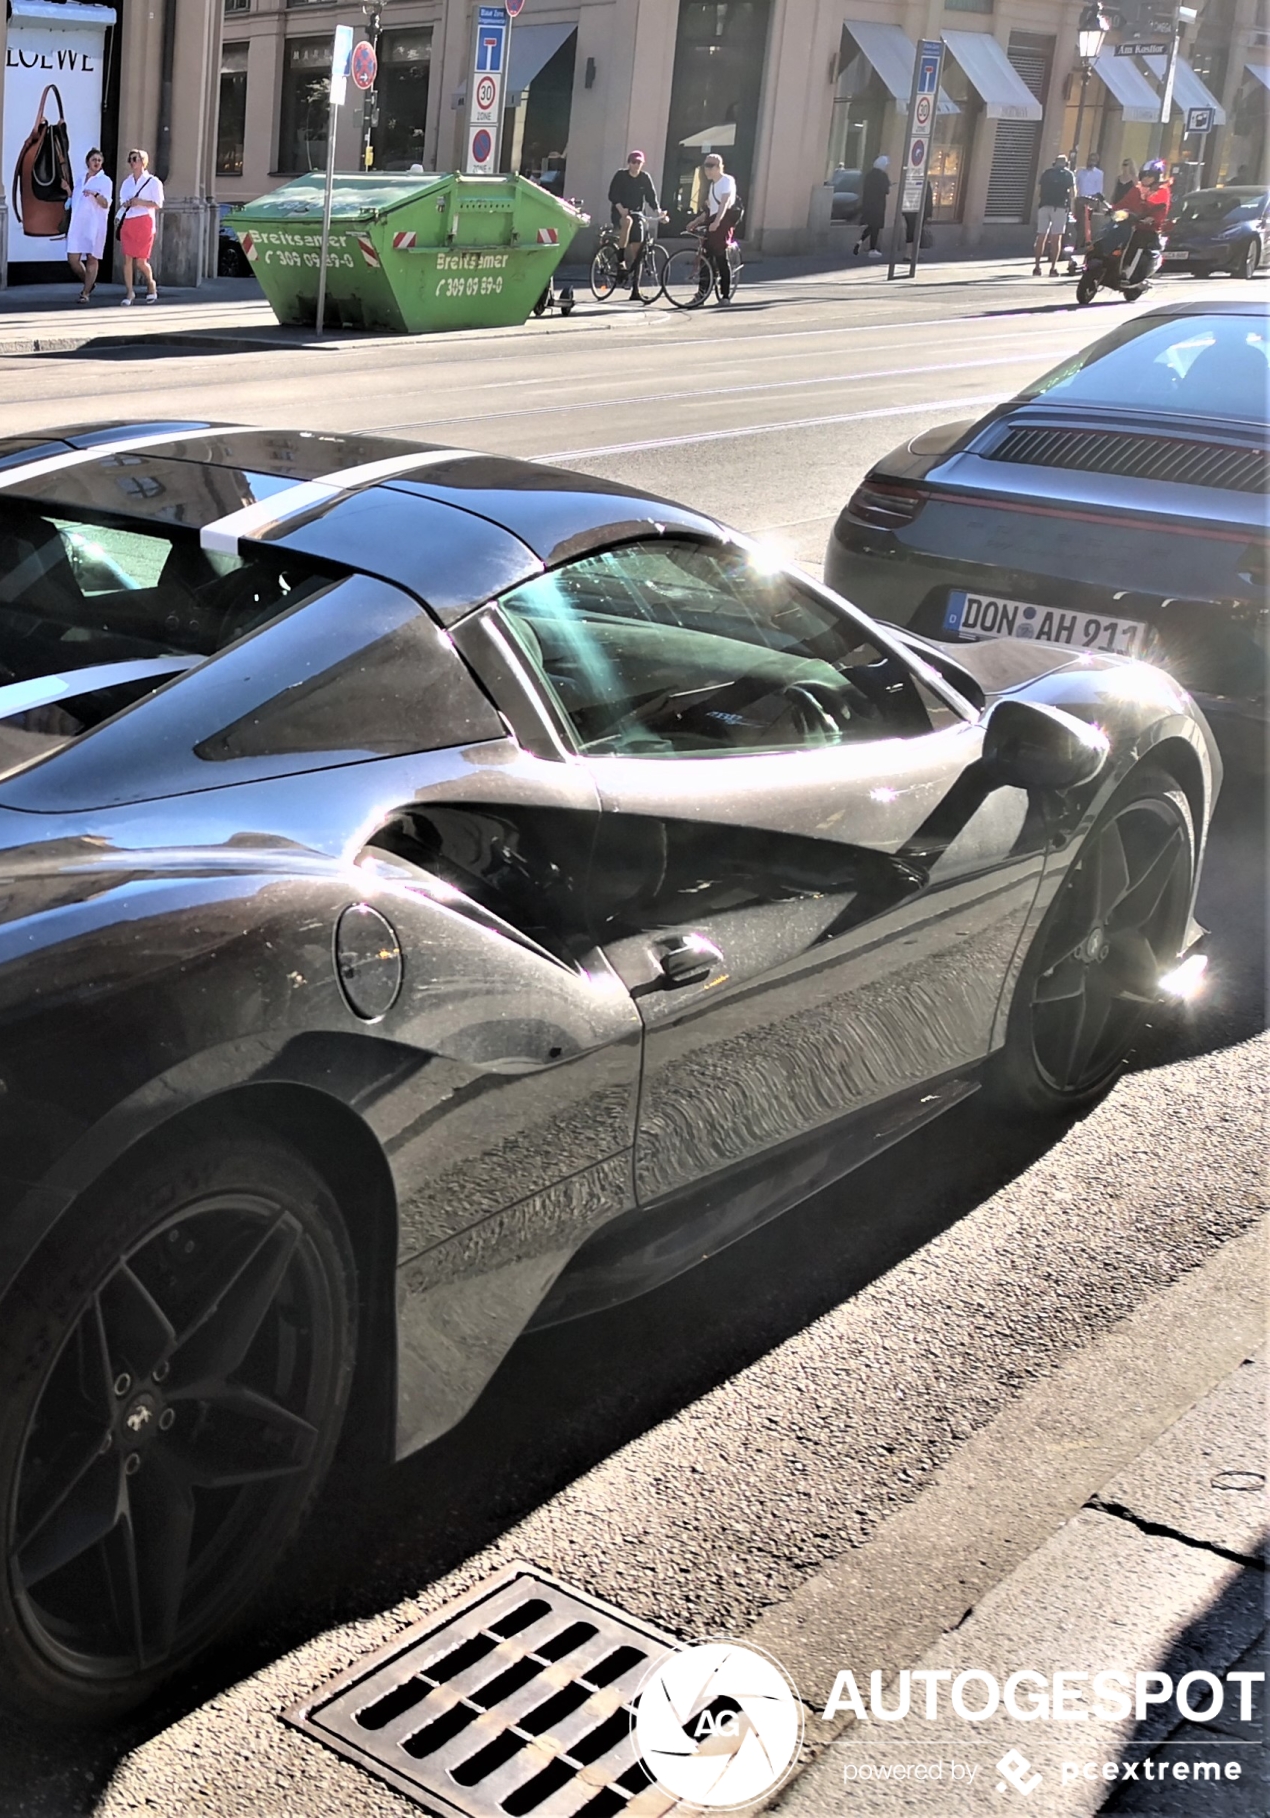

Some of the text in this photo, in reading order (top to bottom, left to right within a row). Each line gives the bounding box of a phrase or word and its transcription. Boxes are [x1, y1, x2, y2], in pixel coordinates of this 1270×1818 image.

[480, 84, 492, 101] 30
[476, 112, 492, 121] ZONE
[918, 103, 928, 117] 30
[276, 249, 301, 267] 309
[303, 252, 321, 268] 09
[436, 252, 509, 271] Breitsamer
[445, 275, 503, 297] 309 09 89-0
[961, 597, 1138, 653] DON AH 911
